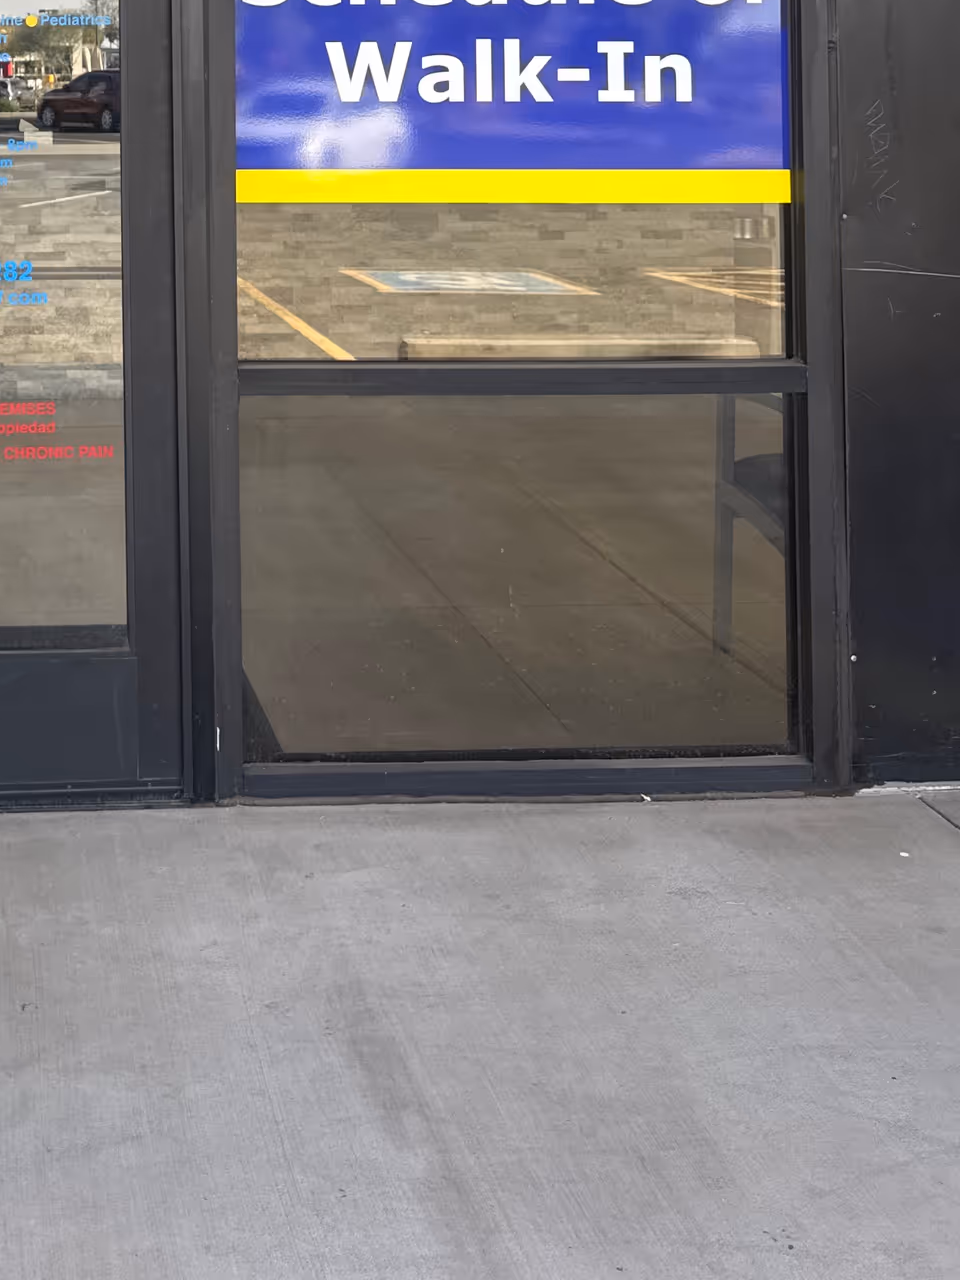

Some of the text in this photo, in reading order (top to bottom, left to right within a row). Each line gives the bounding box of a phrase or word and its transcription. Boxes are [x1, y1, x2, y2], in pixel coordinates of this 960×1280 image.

[40, 13, 112, 26] Pediatrics
[325, 37, 693, 104] Walk-In
[3, 445, 74, 460] CHRONIC
[78, 445, 114, 459] PAIN
